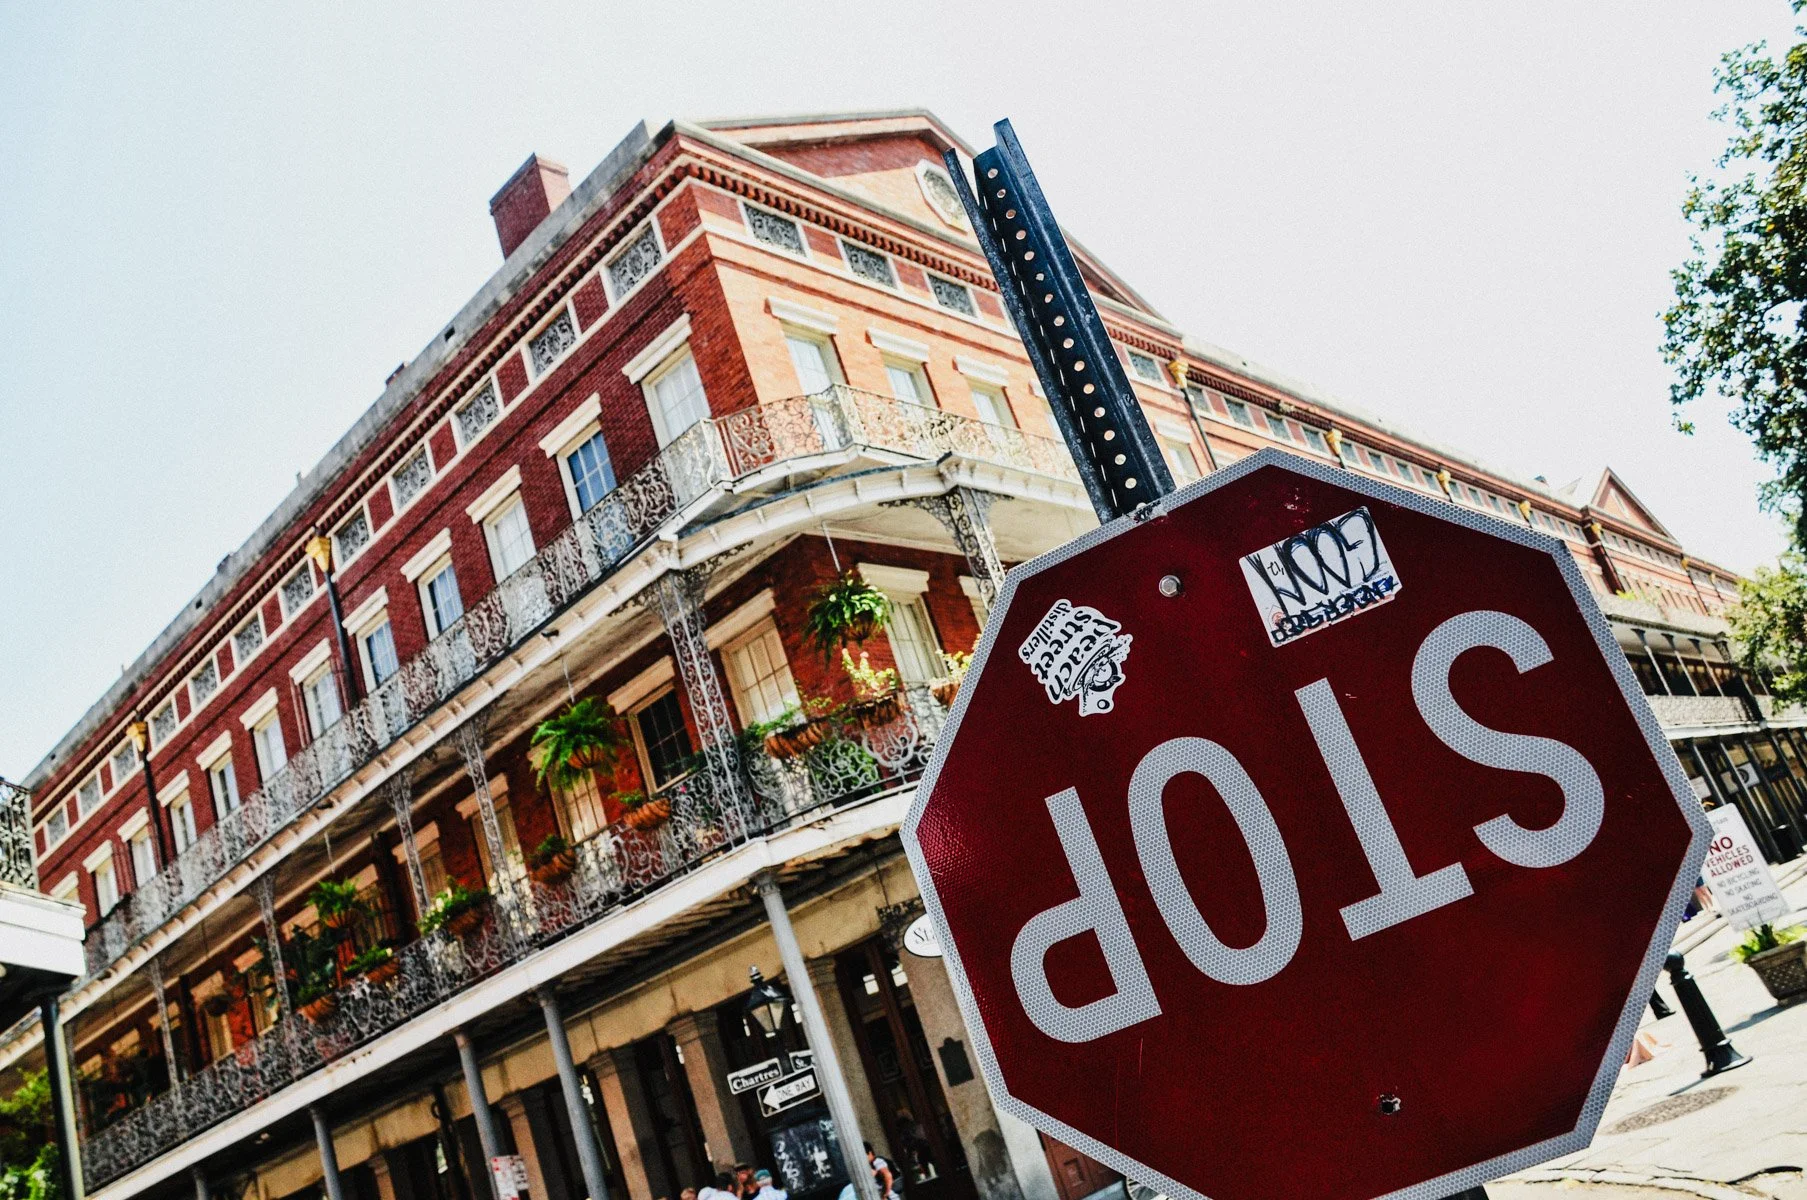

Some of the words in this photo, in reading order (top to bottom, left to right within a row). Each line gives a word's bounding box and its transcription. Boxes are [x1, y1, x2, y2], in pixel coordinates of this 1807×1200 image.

[1021, 602, 1071, 660] distillers
[1034, 610, 1092, 680] street
[1010, 610, 1604, 1043] STOP
[1704, 844, 1750, 868] VEHICLES
[1709, 836, 1733, 856] NO
[1710, 854, 1754, 878] ALLOWED
[732, 1068, 779, 1090] Chartres
